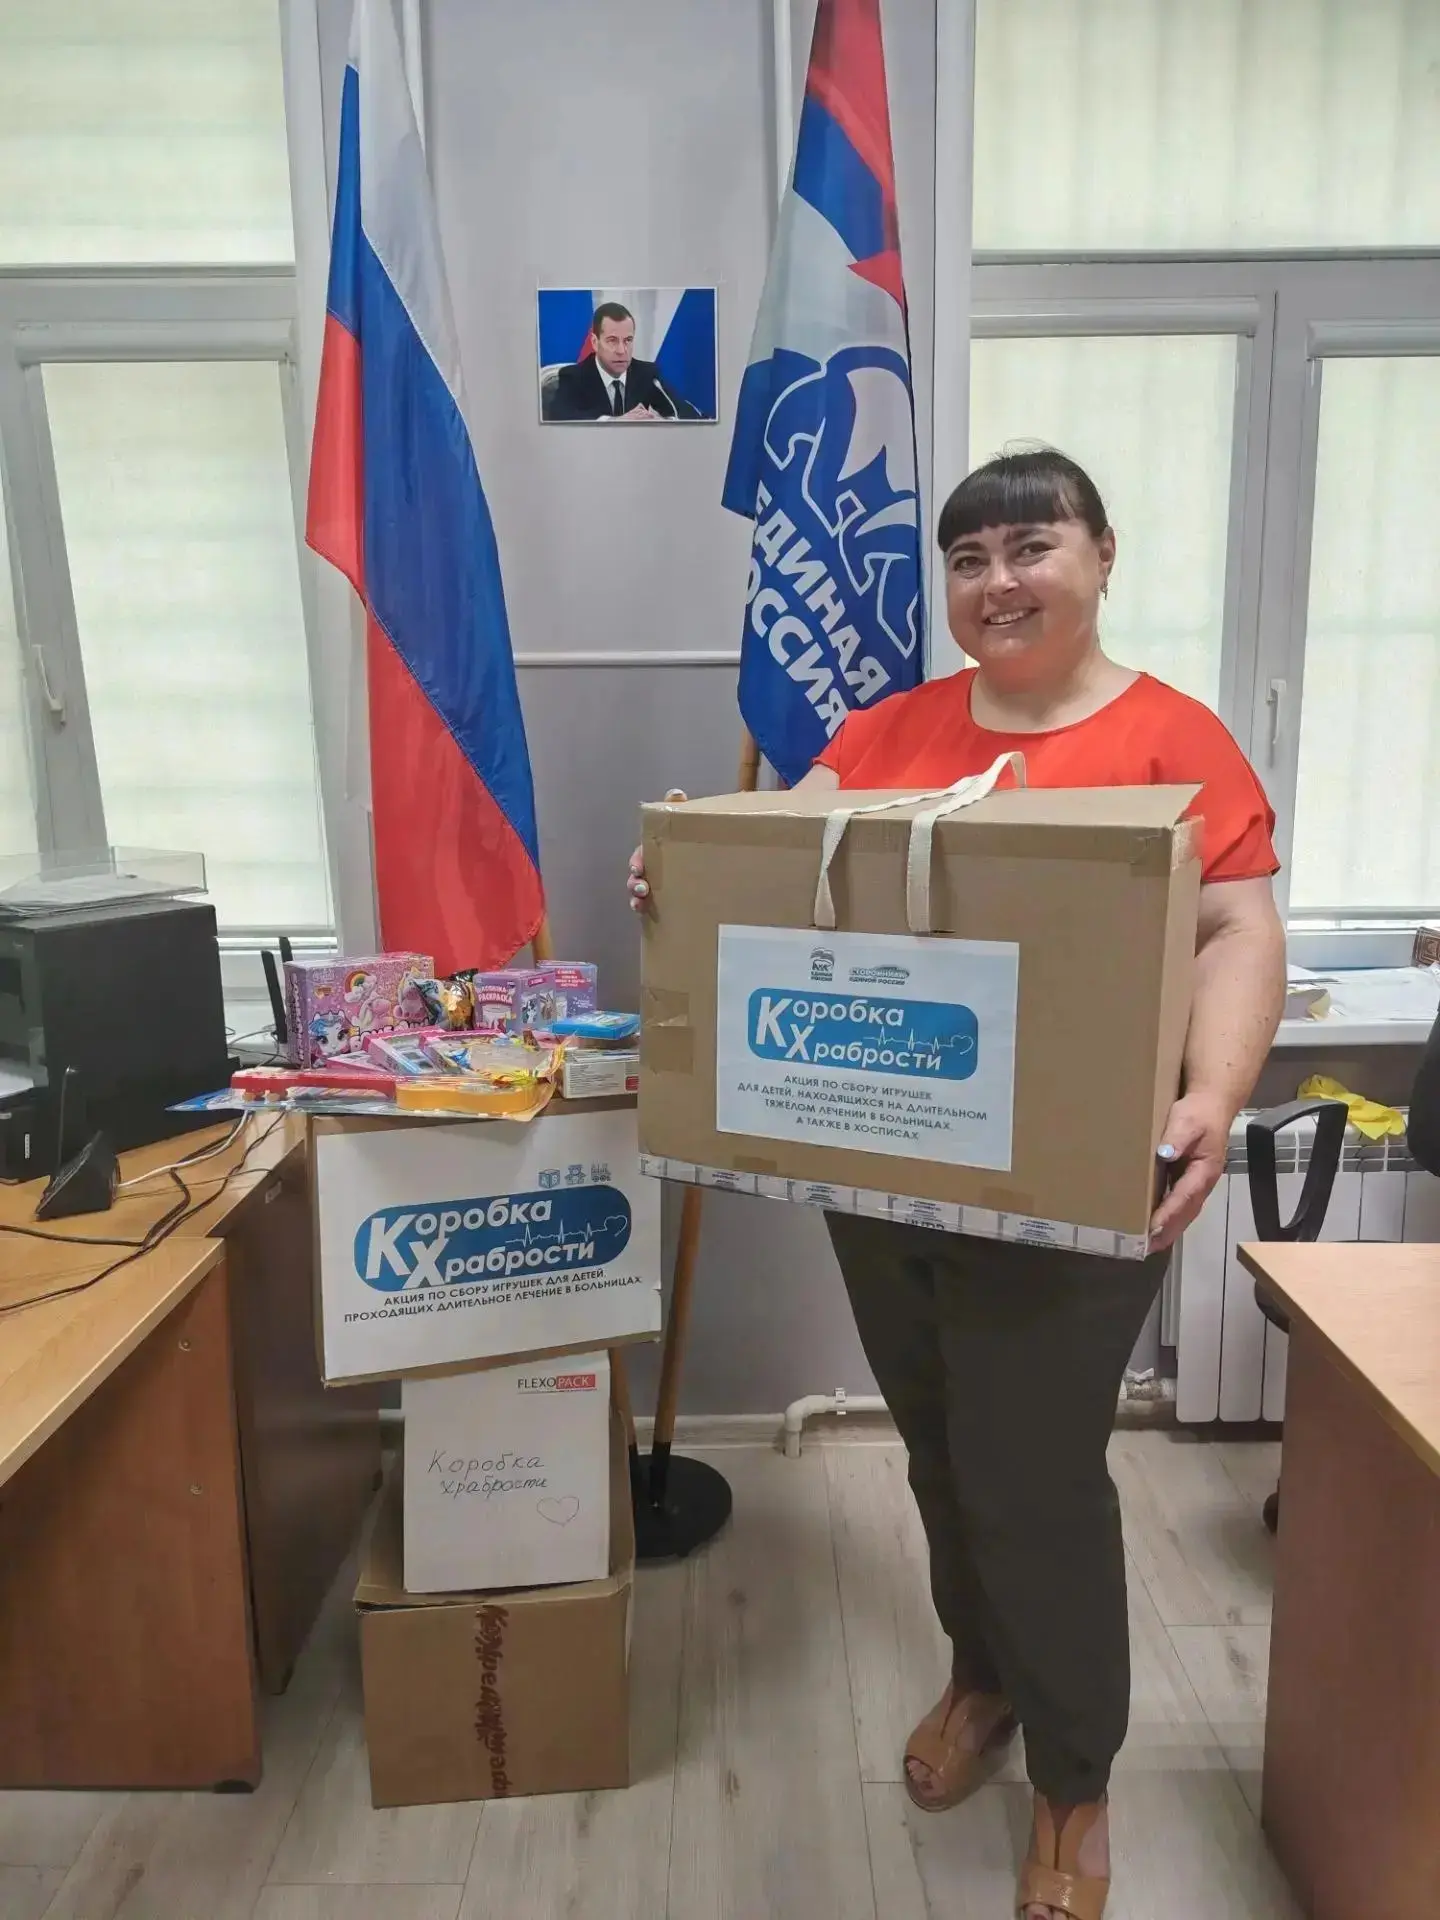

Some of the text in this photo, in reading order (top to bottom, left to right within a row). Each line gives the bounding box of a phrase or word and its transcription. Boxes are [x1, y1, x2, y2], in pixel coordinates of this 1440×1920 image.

[745, 557, 850, 737] ОССИЯ
[755, 995, 905, 1048] Коробка
[784, 1023, 942, 1071] Храбрости
[737, 1082, 987, 1121] ДЛЯ ДЕТЕЙ, НАХОДЯЩИХСЯ НА ДЛИТЕЛЬНОМ
[783, 1075, 933, 1100] АКЦИЯ ПО СБОРУ ИГРУШЕК
[796, 1116, 920, 1140] А ТАКЖЕ В ХОСПИСАХ
[819, 1106, 867, 1119] ЛЕЧЕНИИ
[870, 1111, 877, 1120] В
[365, 1197, 553, 1280] Коробка
[401, 1237, 597, 1290] Храбрости
[344, 1275, 643, 1323] ПРОХОДЯЩИХ ДЛИТЕЛЬНОЕ ЛЕЧЕНИЕ В БОЛЬНИЦАХ
[384, 1293, 425, 1306] АКЦИЯ
[428, 1290, 446, 1301] ПО
[449, 1285, 489, 1298] СБОРУ
[492, 1278, 543, 1292] ИГРУШЕК
[546, 1274, 569, 1286] ДЛЯ
[517, 1375, 590, 1389] FLEXOPACK
[427, 1449, 545, 1479] Коробка
[440, 1475, 548, 1500] храбрости
